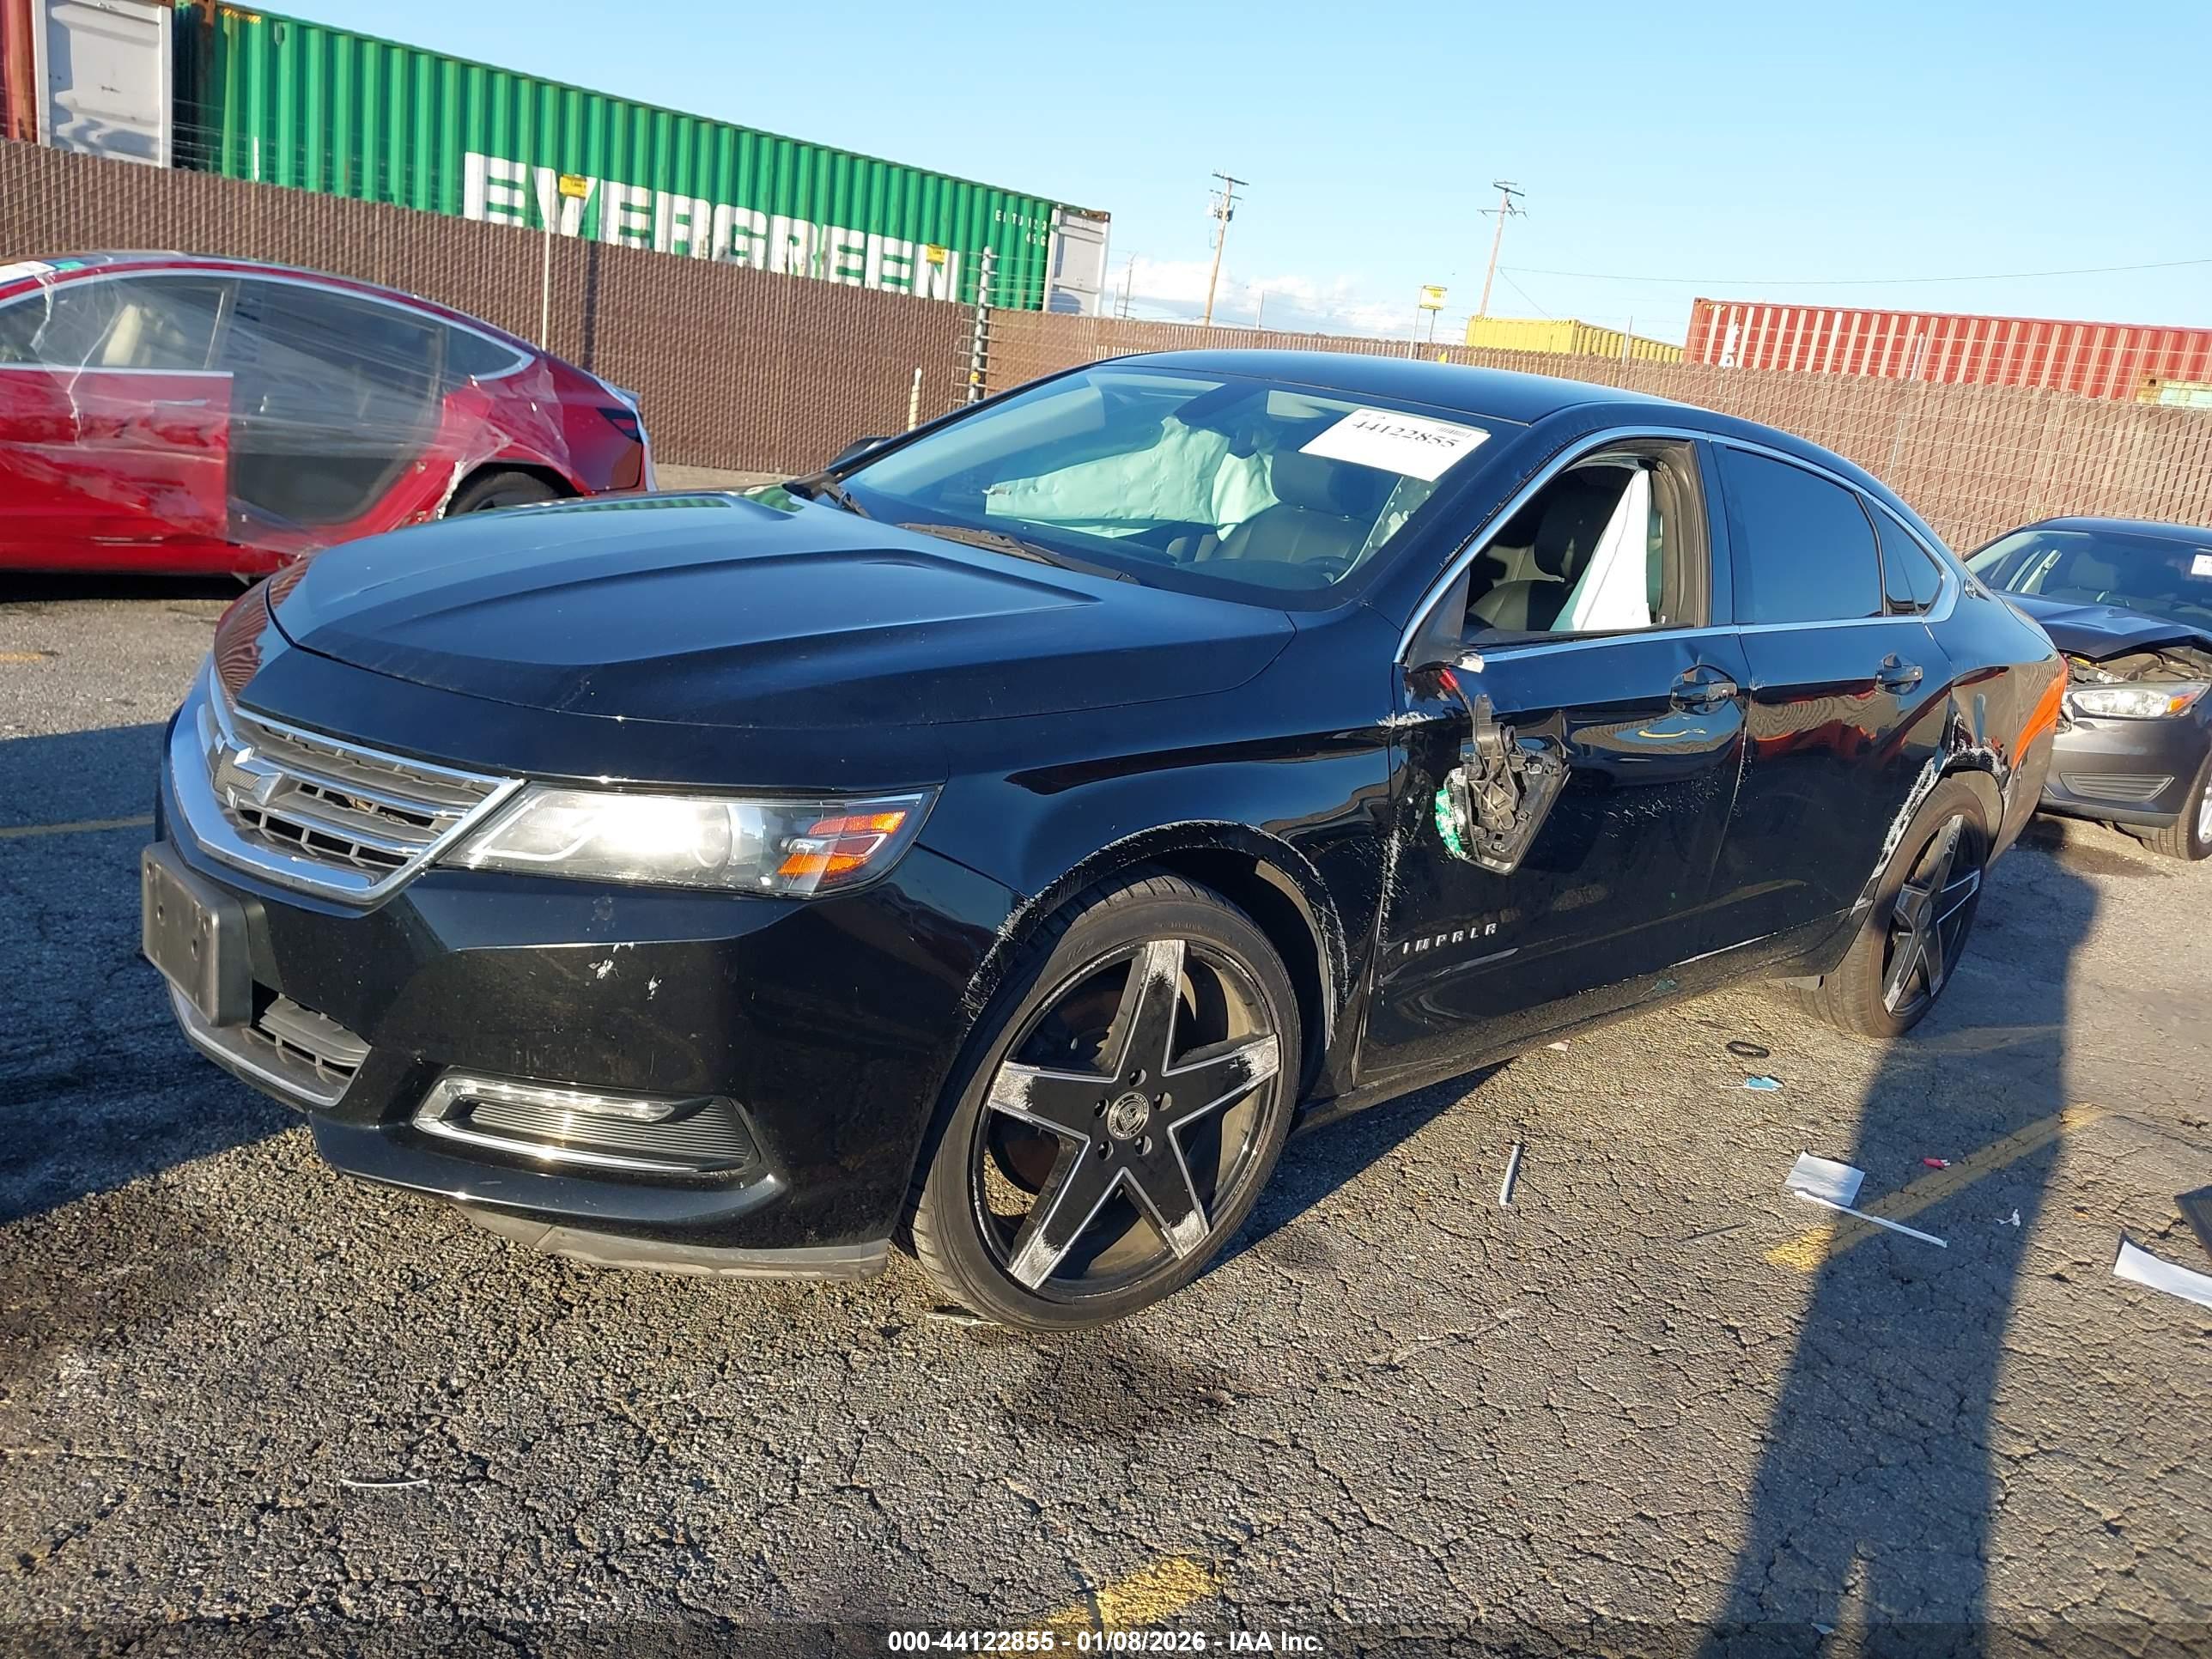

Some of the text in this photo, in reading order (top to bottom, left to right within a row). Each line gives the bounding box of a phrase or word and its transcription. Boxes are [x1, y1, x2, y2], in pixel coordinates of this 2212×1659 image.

[464, 152, 959, 302] EVERGREEN
[1353, 422, 1460, 447] 44122855
[1402, 923, 1497, 955] IMPALA
